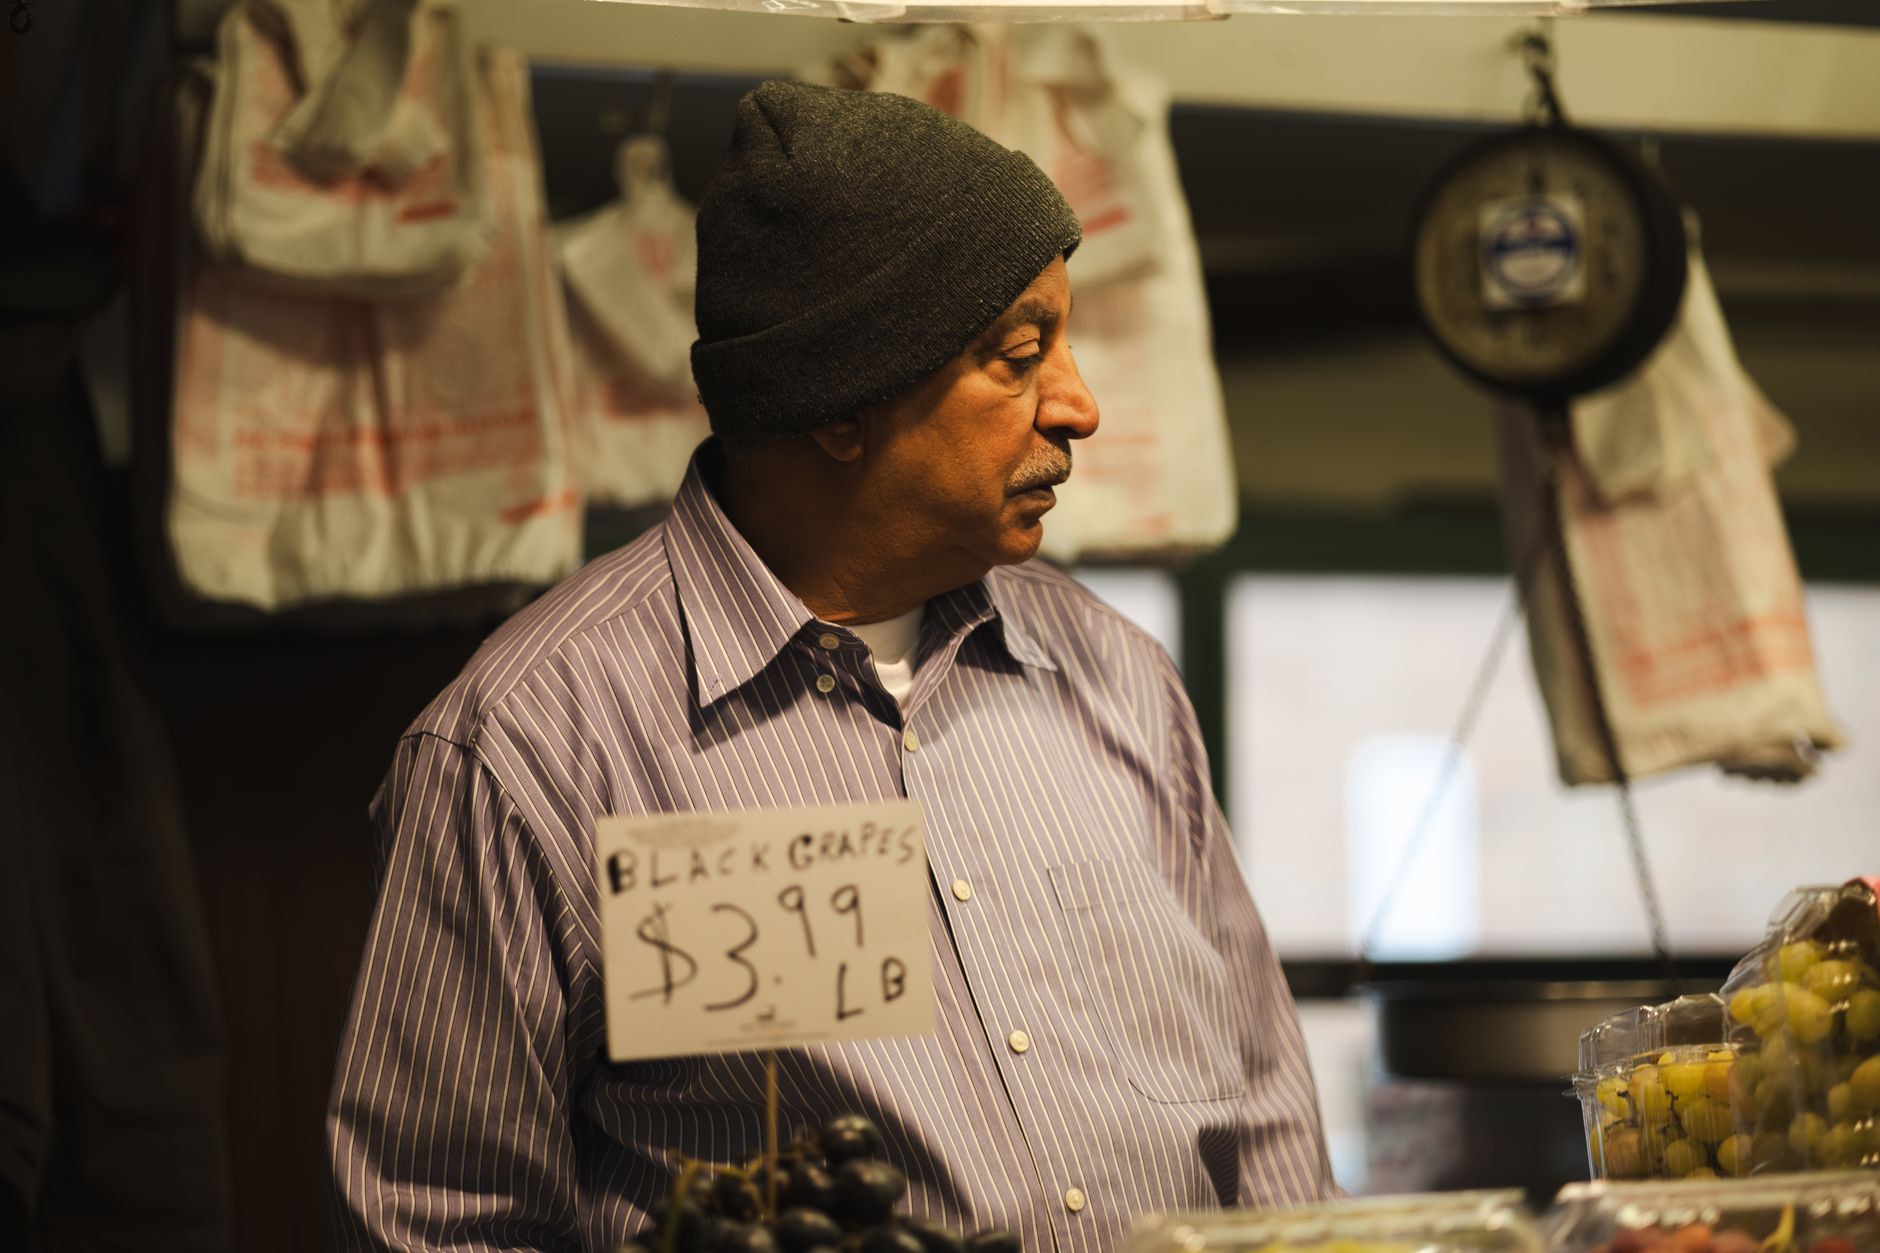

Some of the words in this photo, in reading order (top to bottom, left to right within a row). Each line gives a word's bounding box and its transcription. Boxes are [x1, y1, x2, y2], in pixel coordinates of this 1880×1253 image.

[606, 845, 772, 895] BLACK
[787, 821, 917, 871] GRAPES
[629, 883, 865, 1012] $3.99
[836, 956, 907, 1021] LB
